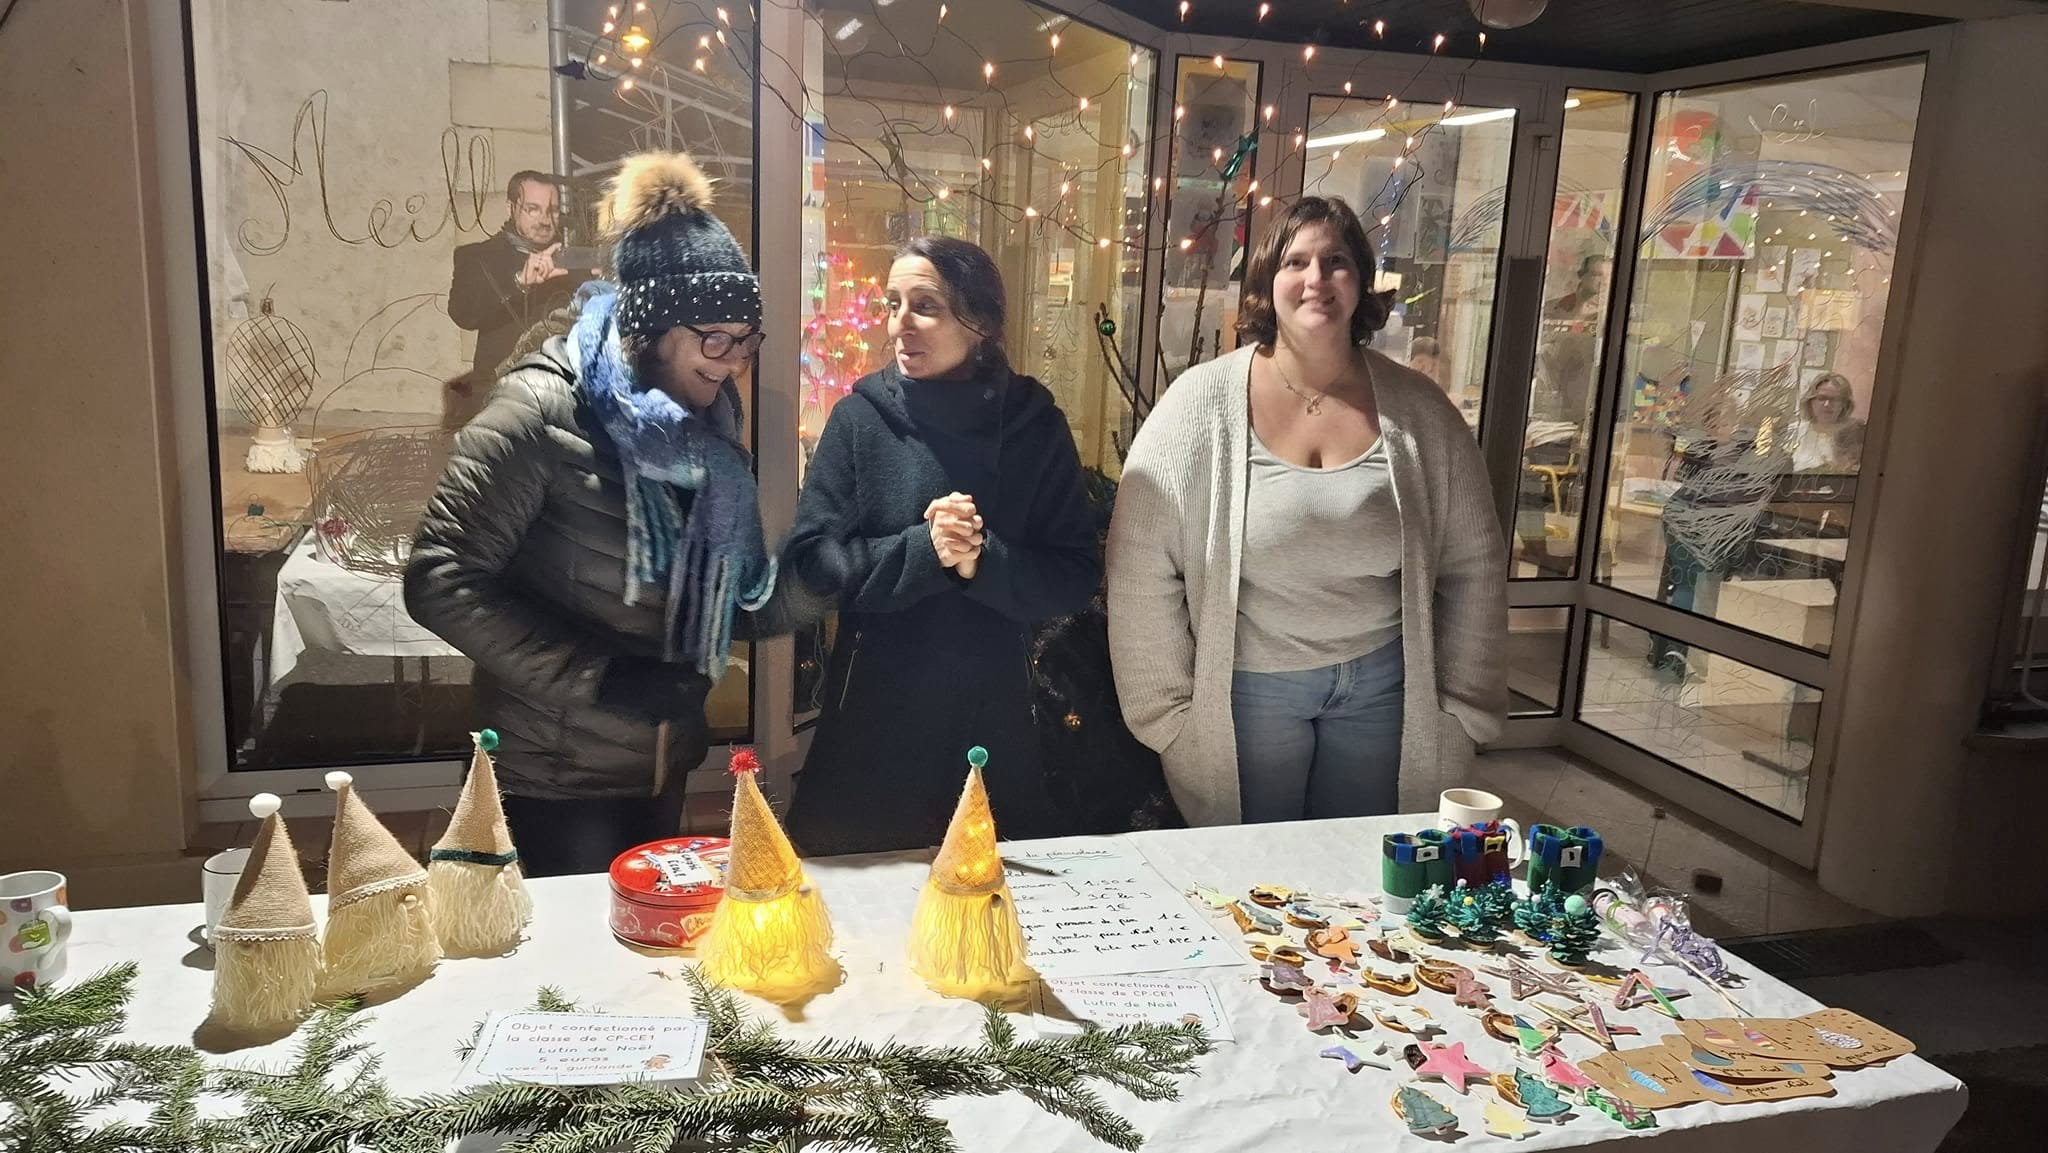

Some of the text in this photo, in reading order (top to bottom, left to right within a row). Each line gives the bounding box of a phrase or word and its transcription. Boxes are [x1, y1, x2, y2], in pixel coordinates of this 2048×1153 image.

[1050, 979, 1199, 992] Objet confectionné par
[1069, 988, 1106, 996] classe
[1111, 989, 1127, 997] de
[1083, 999, 1118, 1008] Lutin
[1125, 1000, 1141, 1008] de
[1106, 1011, 1149, 1019] euros
[511, 1022, 690, 1033] Objet confectionné par
[506, 1034, 656, 1042] la classe de CP-CE1
[538, 1046, 579, 1054] Lutin
[566, 1062, 634, 1073] guirlande
